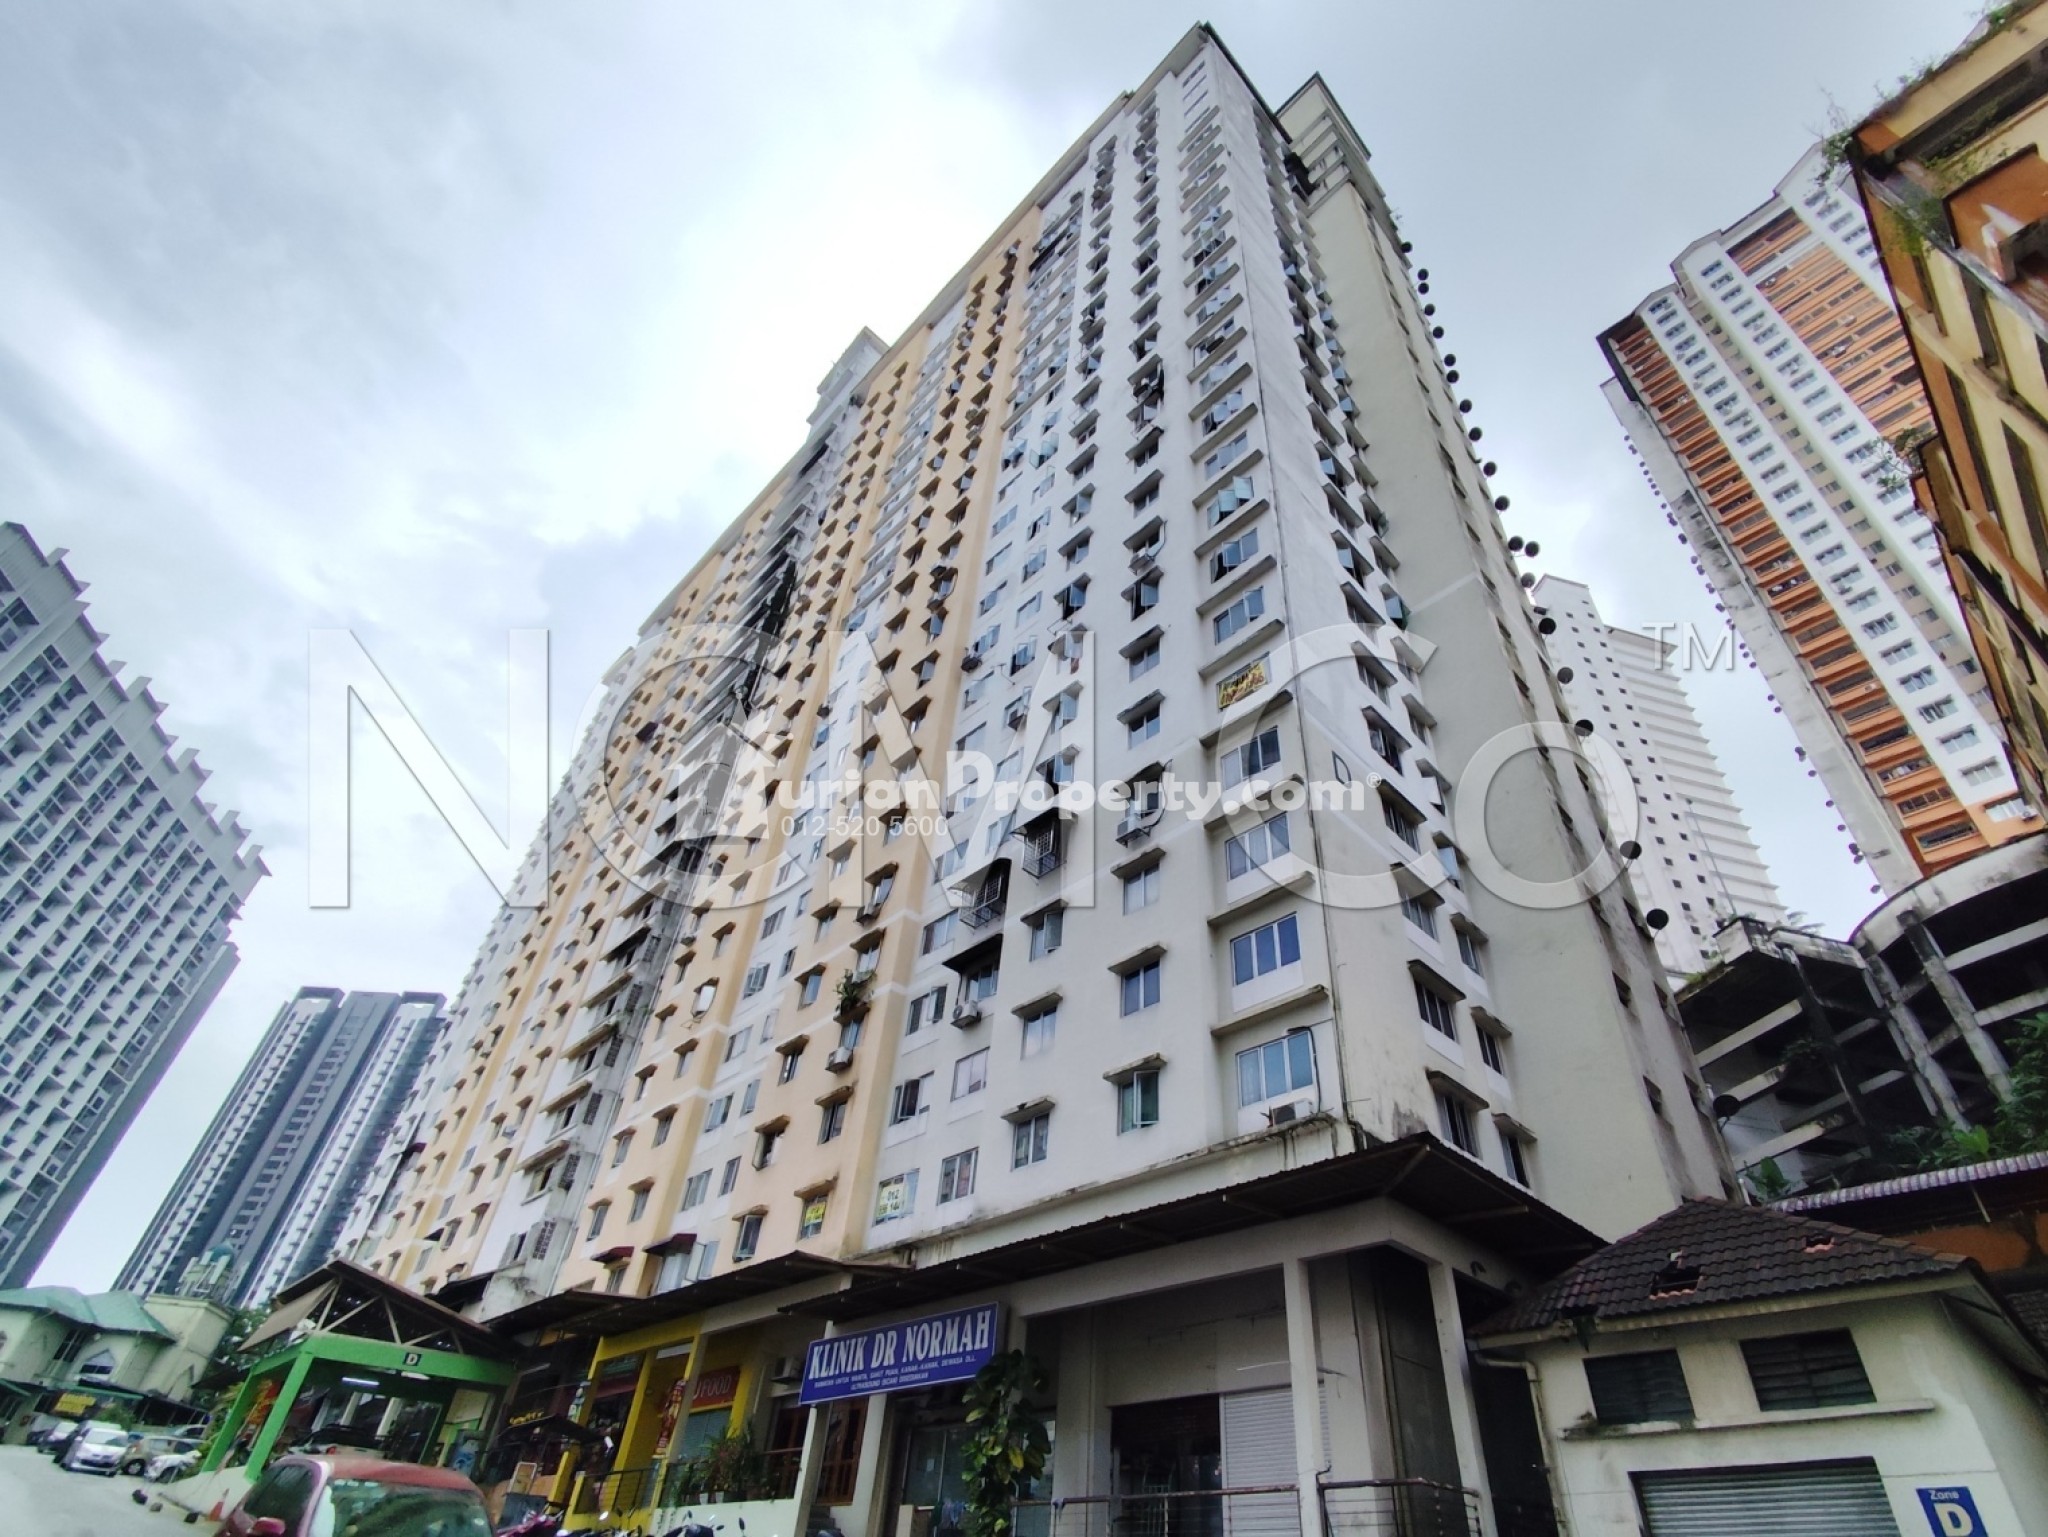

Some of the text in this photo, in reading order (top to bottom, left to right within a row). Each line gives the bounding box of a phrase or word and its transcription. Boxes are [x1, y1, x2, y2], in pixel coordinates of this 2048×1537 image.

[808, 1310, 992, 1380] KLINIK DR NORMAH
[406, 1353, 418, 1366] D
[1928, 1489, 1960, 1500] Zone
[1933, 1502, 1974, 1537] D
